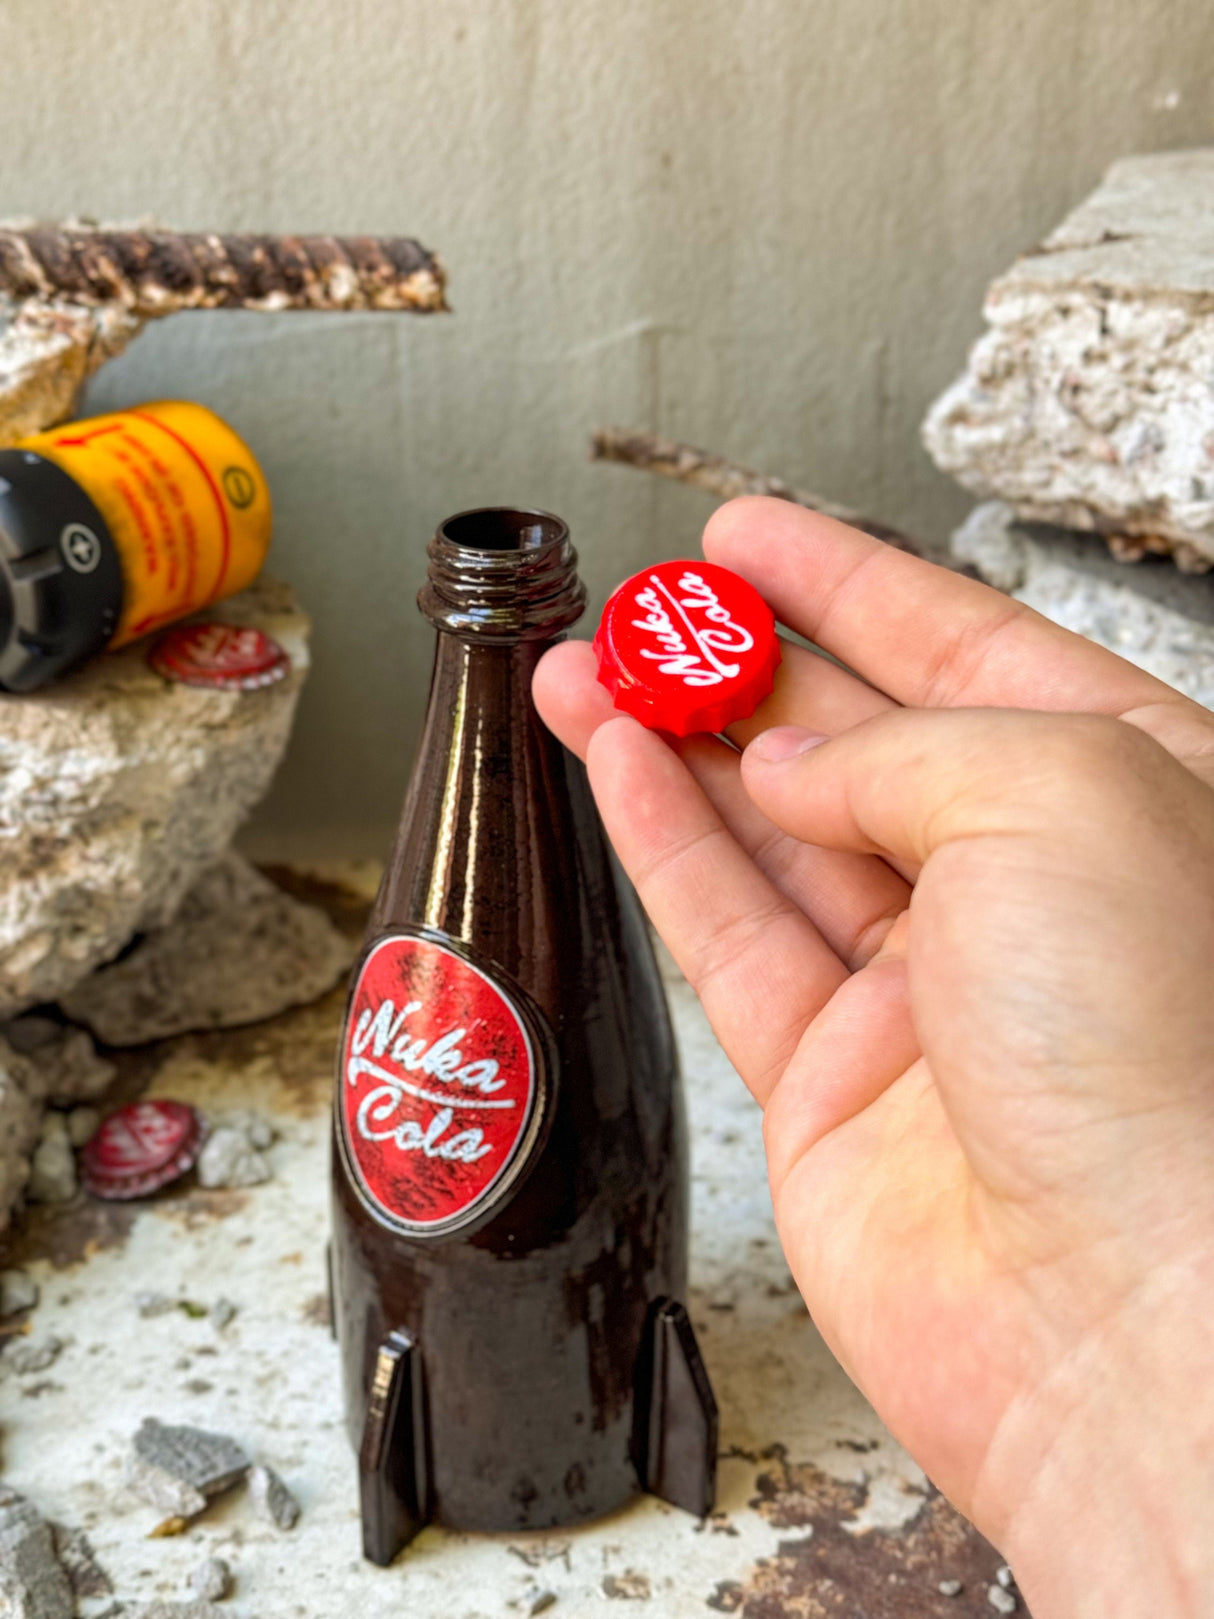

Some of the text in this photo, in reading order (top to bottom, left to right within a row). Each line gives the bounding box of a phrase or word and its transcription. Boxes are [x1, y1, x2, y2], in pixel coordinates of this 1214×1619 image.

[632, 587, 723, 686] Nuka
[678, 571, 754, 653] Cola
[352, 1000, 506, 1093] Nuka
[357, 1085, 493, 1163] Cola
